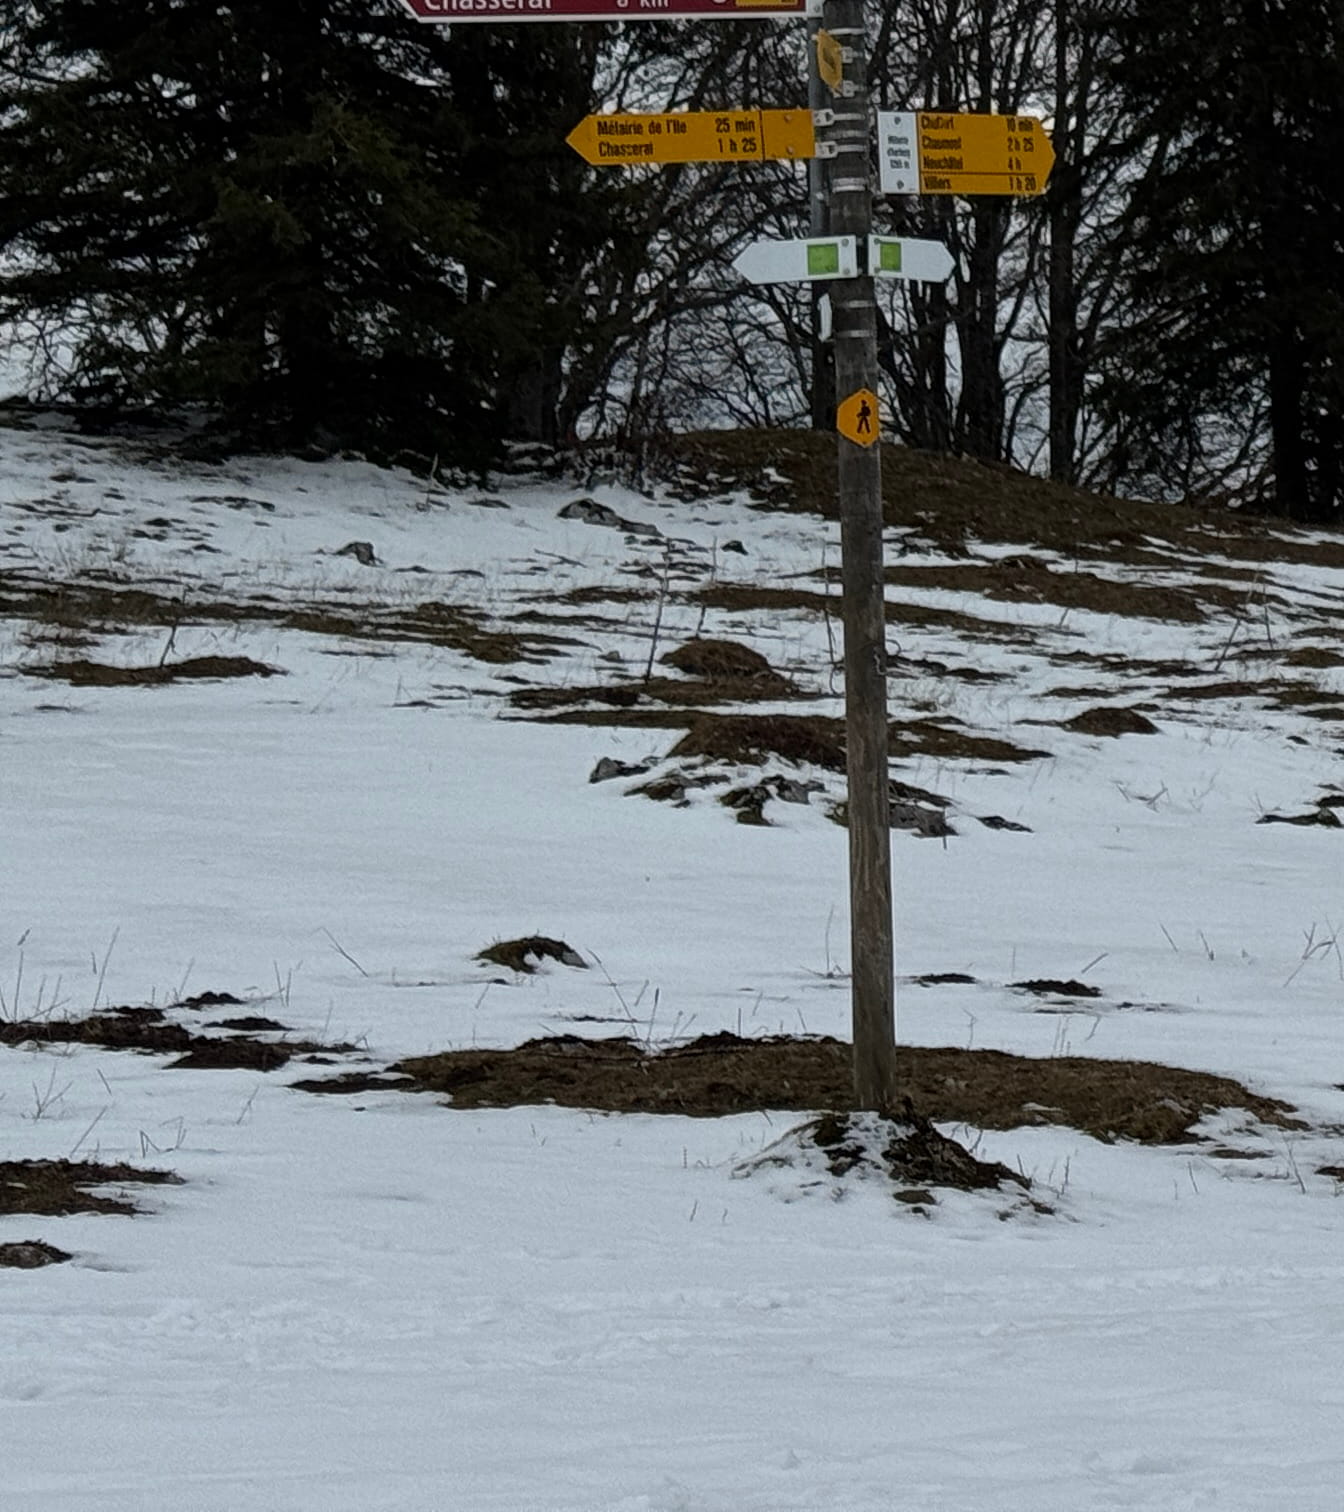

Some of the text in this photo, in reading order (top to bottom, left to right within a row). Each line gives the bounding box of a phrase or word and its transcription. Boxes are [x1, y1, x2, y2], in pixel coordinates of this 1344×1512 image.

[648, 121, 661, 133] de
[715, 118, 730, 133] 25
[736, 118, 755, 132] min
[599, 141, 653, 157] Chasseral
[730, 139, 737, 152] h
[742, 138, 757, 153] 25
